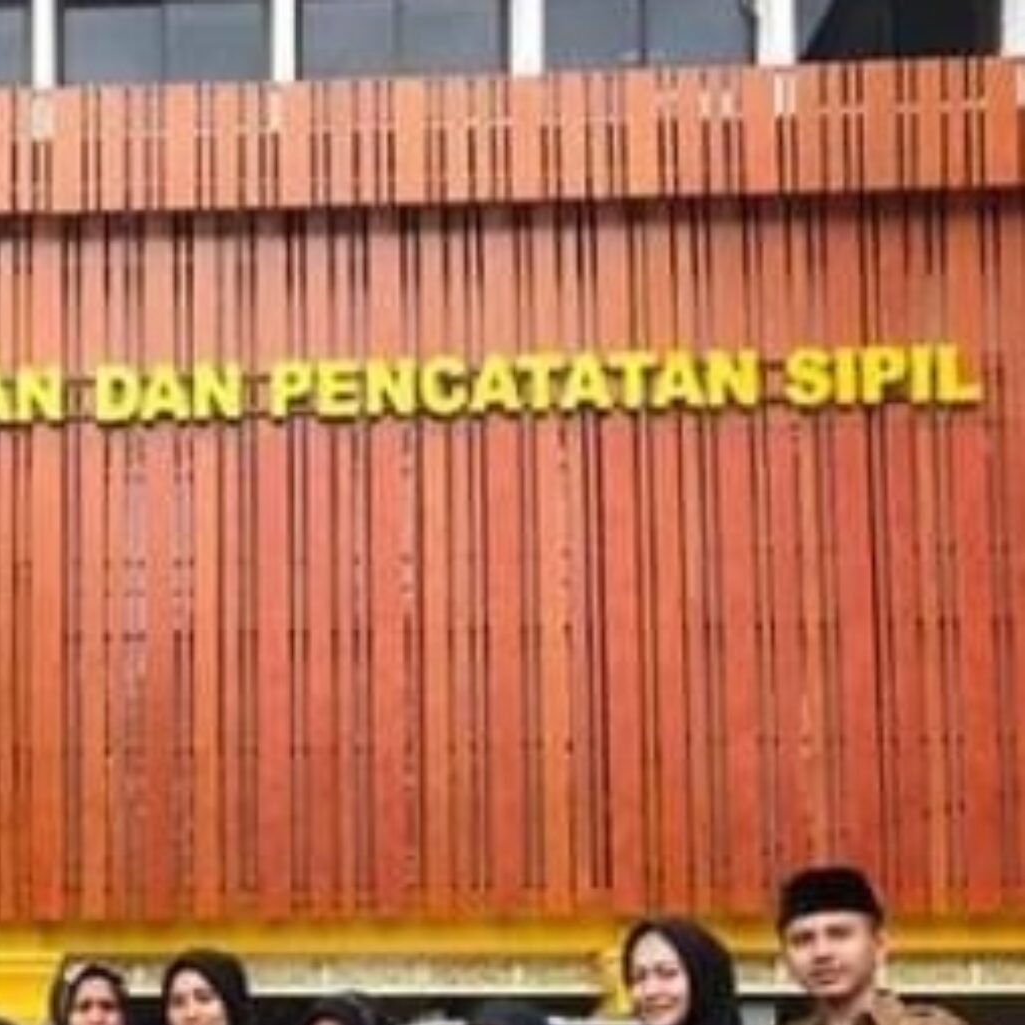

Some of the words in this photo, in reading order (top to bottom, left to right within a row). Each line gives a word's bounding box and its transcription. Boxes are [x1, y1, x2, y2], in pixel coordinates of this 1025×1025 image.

[92, 360, 245, 424] DAN
[268, 352, 760, 418] PENCATATAN
[783, 344, 982, 407] SIPIL
